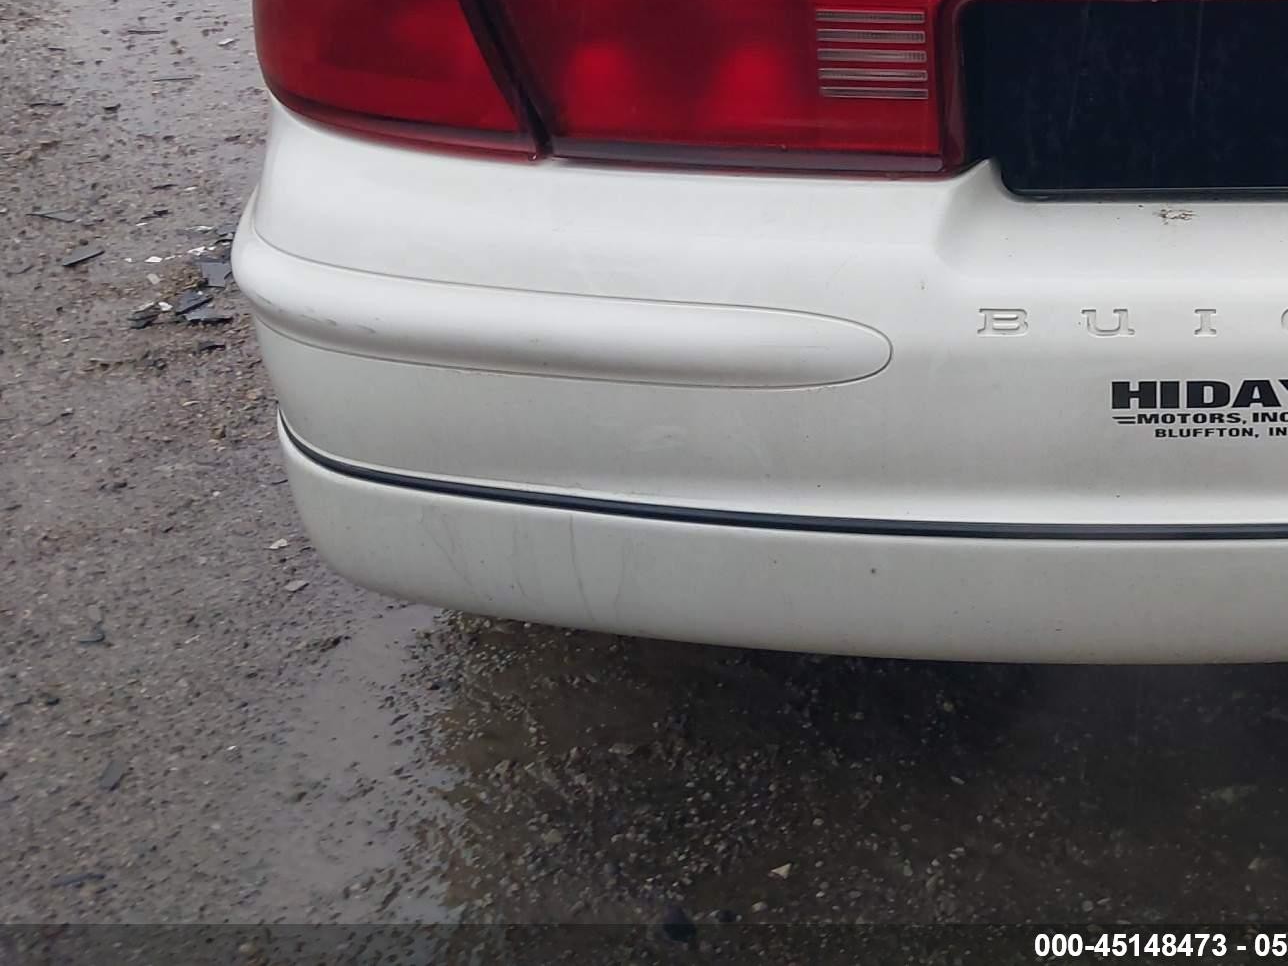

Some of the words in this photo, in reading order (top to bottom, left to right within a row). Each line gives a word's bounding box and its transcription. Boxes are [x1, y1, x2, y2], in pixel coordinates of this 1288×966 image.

[1136, 412, 1248, 425] MOTORS,
[1154, 427, 1260, 439] BLUFFTON,
[1268, 426, 1288, 437] IN
